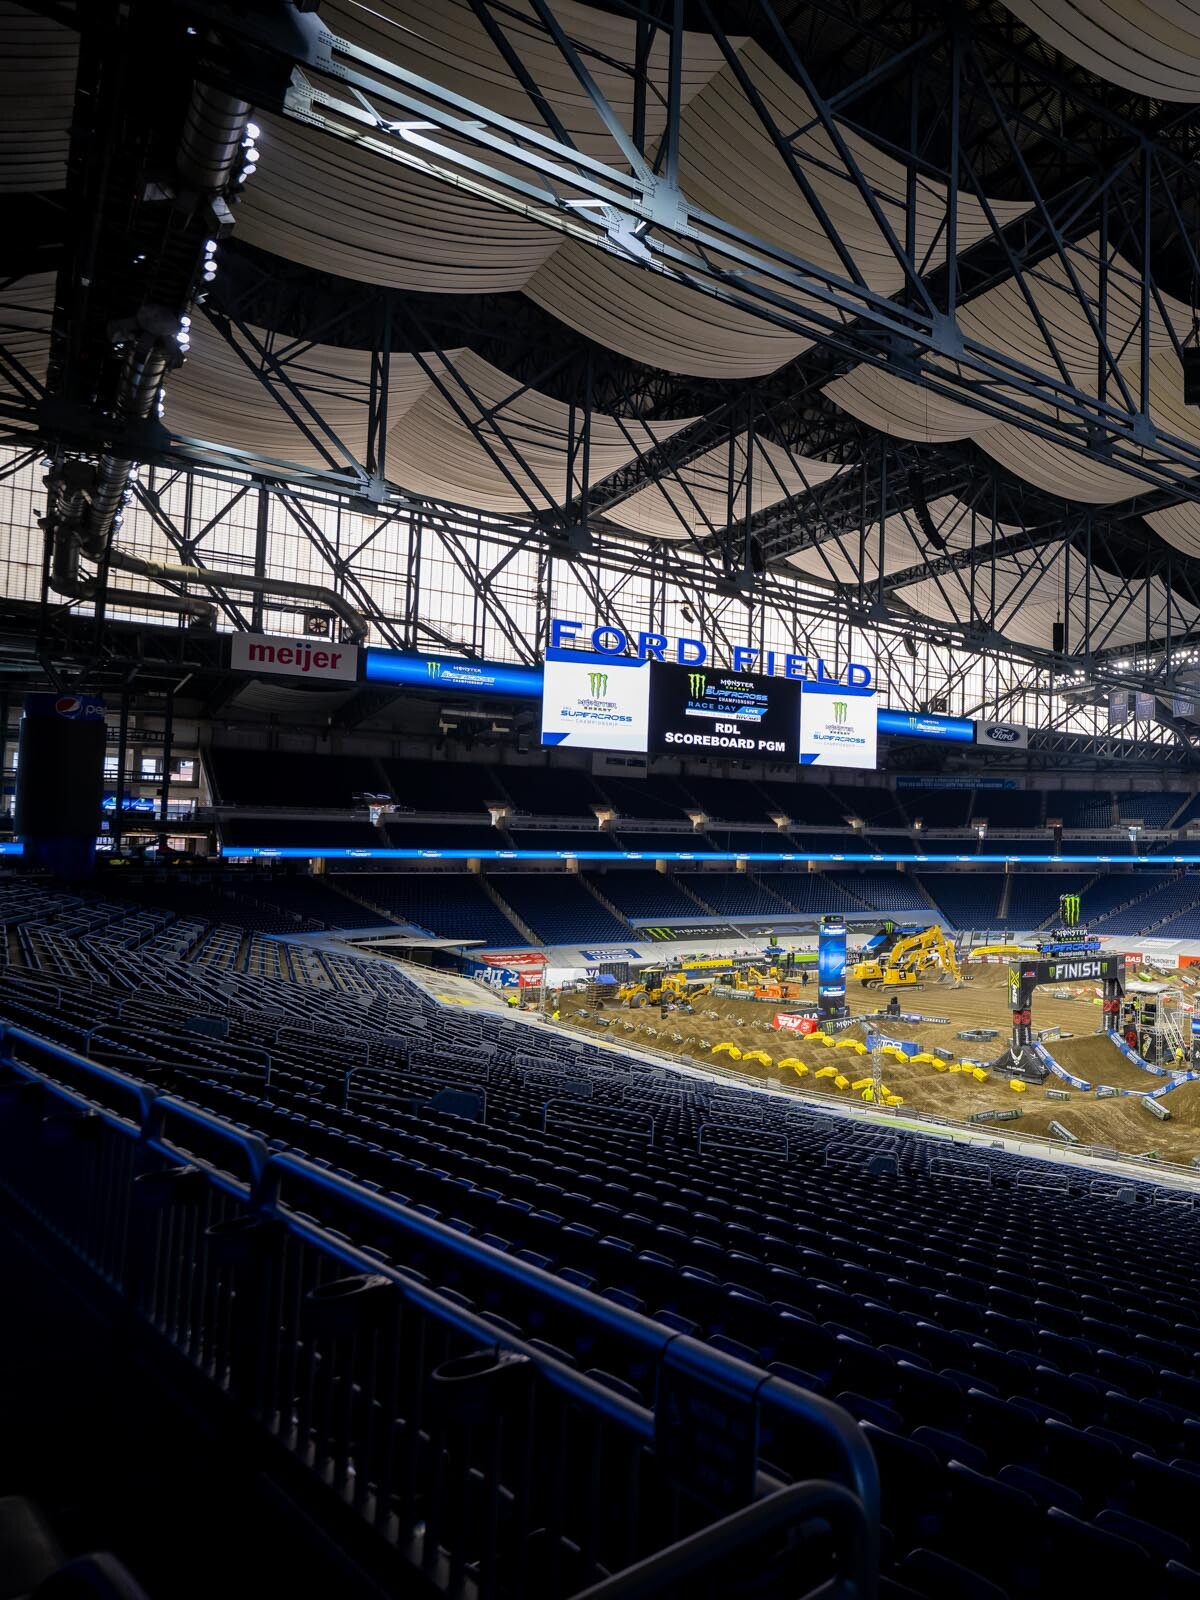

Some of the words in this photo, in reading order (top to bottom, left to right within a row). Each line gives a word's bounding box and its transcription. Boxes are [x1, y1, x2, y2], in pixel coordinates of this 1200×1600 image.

[248, 643, 342, 672] meijer
[551, 618, 708, 667] FORD
[733, 645, 872, 688] FIELD
[720, 679, 754, 689] MONSTER
[705, 688, 768, 702] SUPERCROSS
[718, 697, 756, 706] CHAMPIONSHIP
[86, 704, 107, 714] pe
[688, 701, 714, 710] RACE
[718, 704, 737, 712] DAY
[560, 709, 633, 722] SUPERCROSS
[715, 722, 741, 735] RDL
[991, 727, 1015, 742] Ford
[664, 732, 755, 749] SCOREBOARD
[758, 740, 786, 752] PGM
[812, 734, 866, 744] SUPERCROSS
[674, 927, 732, 935] MONSTER
[1056, 929, 1088, 938] MONSTER
[1042, 942, 1102, 953] SUPERCROSS
[1055, 961, 1101, 980] FINISH
[776, 1015, 802, 1028] FLY
